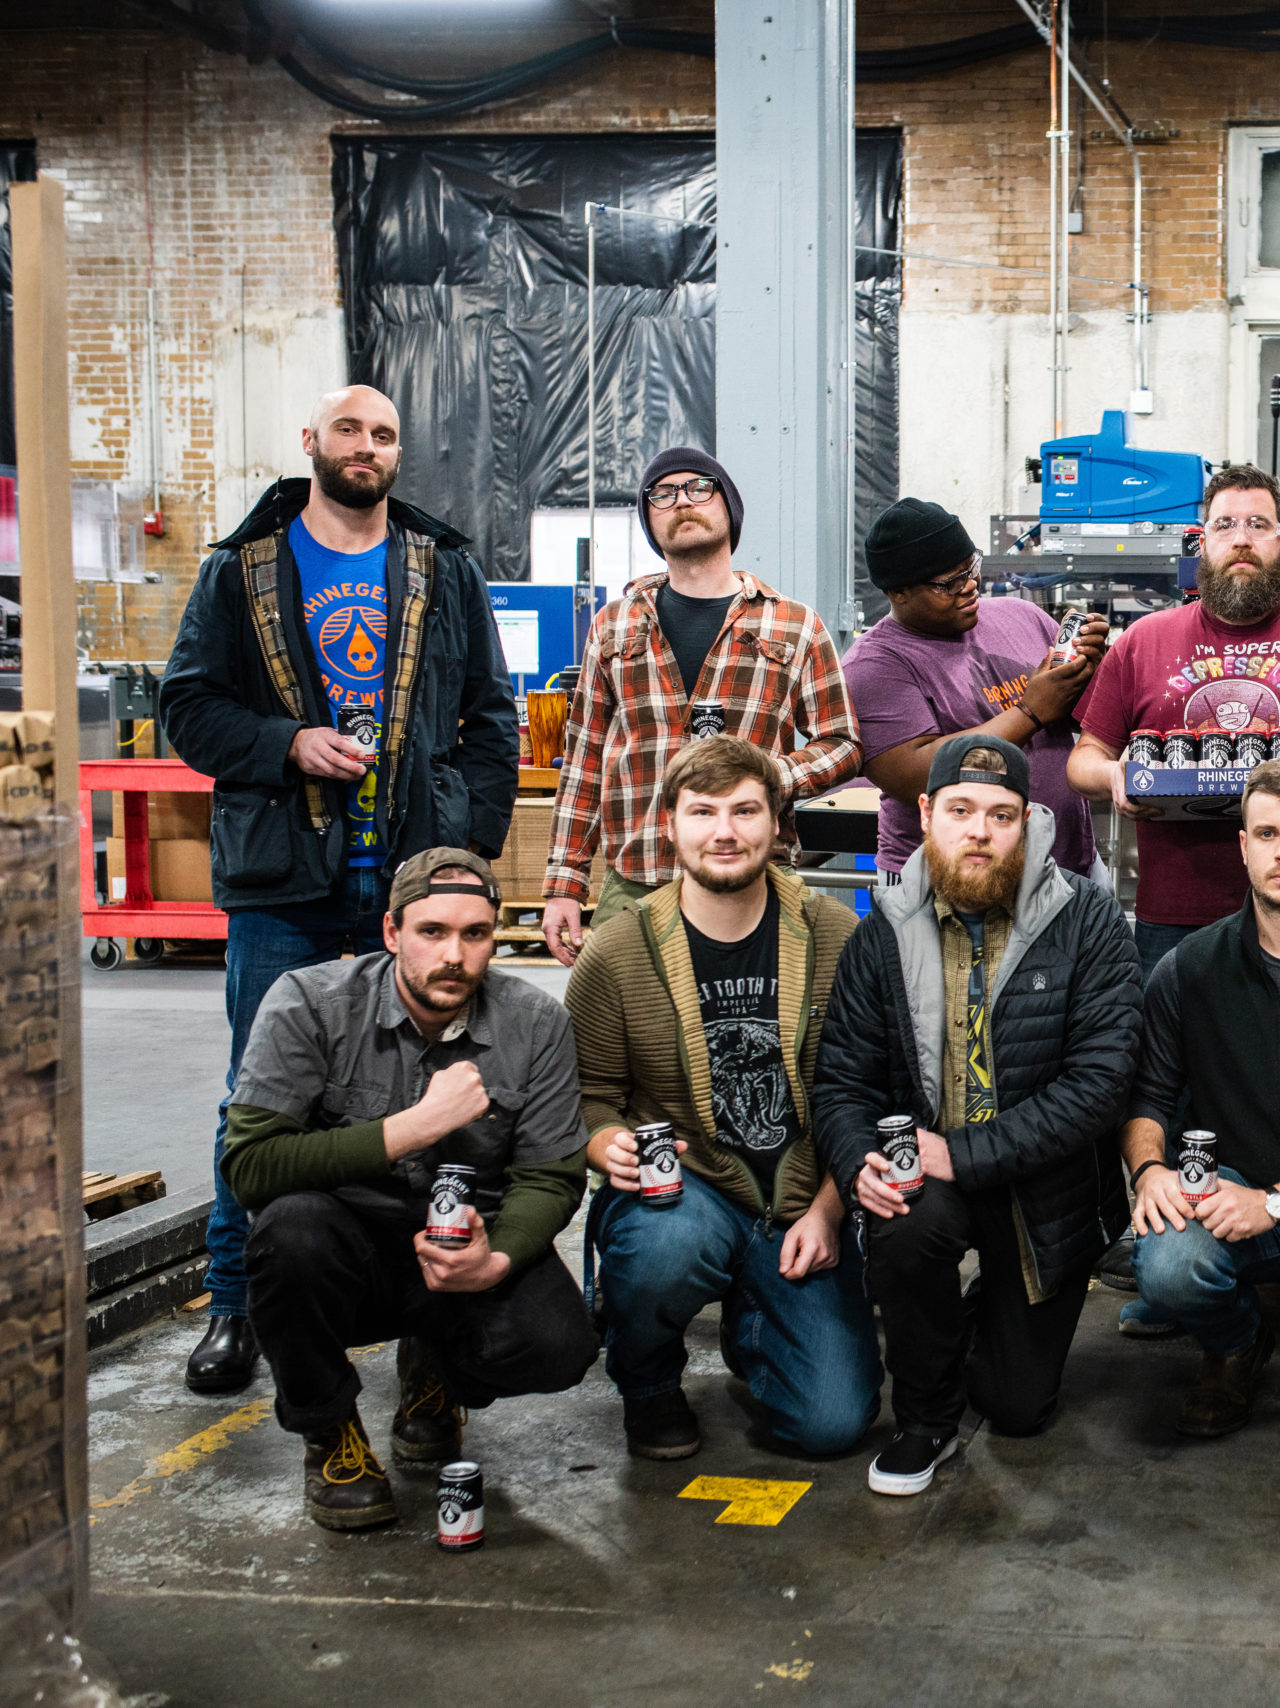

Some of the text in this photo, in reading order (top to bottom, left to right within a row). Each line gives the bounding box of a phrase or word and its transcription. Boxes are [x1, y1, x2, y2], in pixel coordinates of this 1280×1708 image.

[303, 582, 387, 623] HINEGE
[1195, 644, 1216, 655] I'M
[346, 714, 376, 728] RHINEGE
[1198, 771, 1250, 782] RHINEGE
[713, 977, 765, 997] TOOTH
[731, 1006, 748, 1015] IPA
[882, 1135, 918, 1153] RHINEGEI
